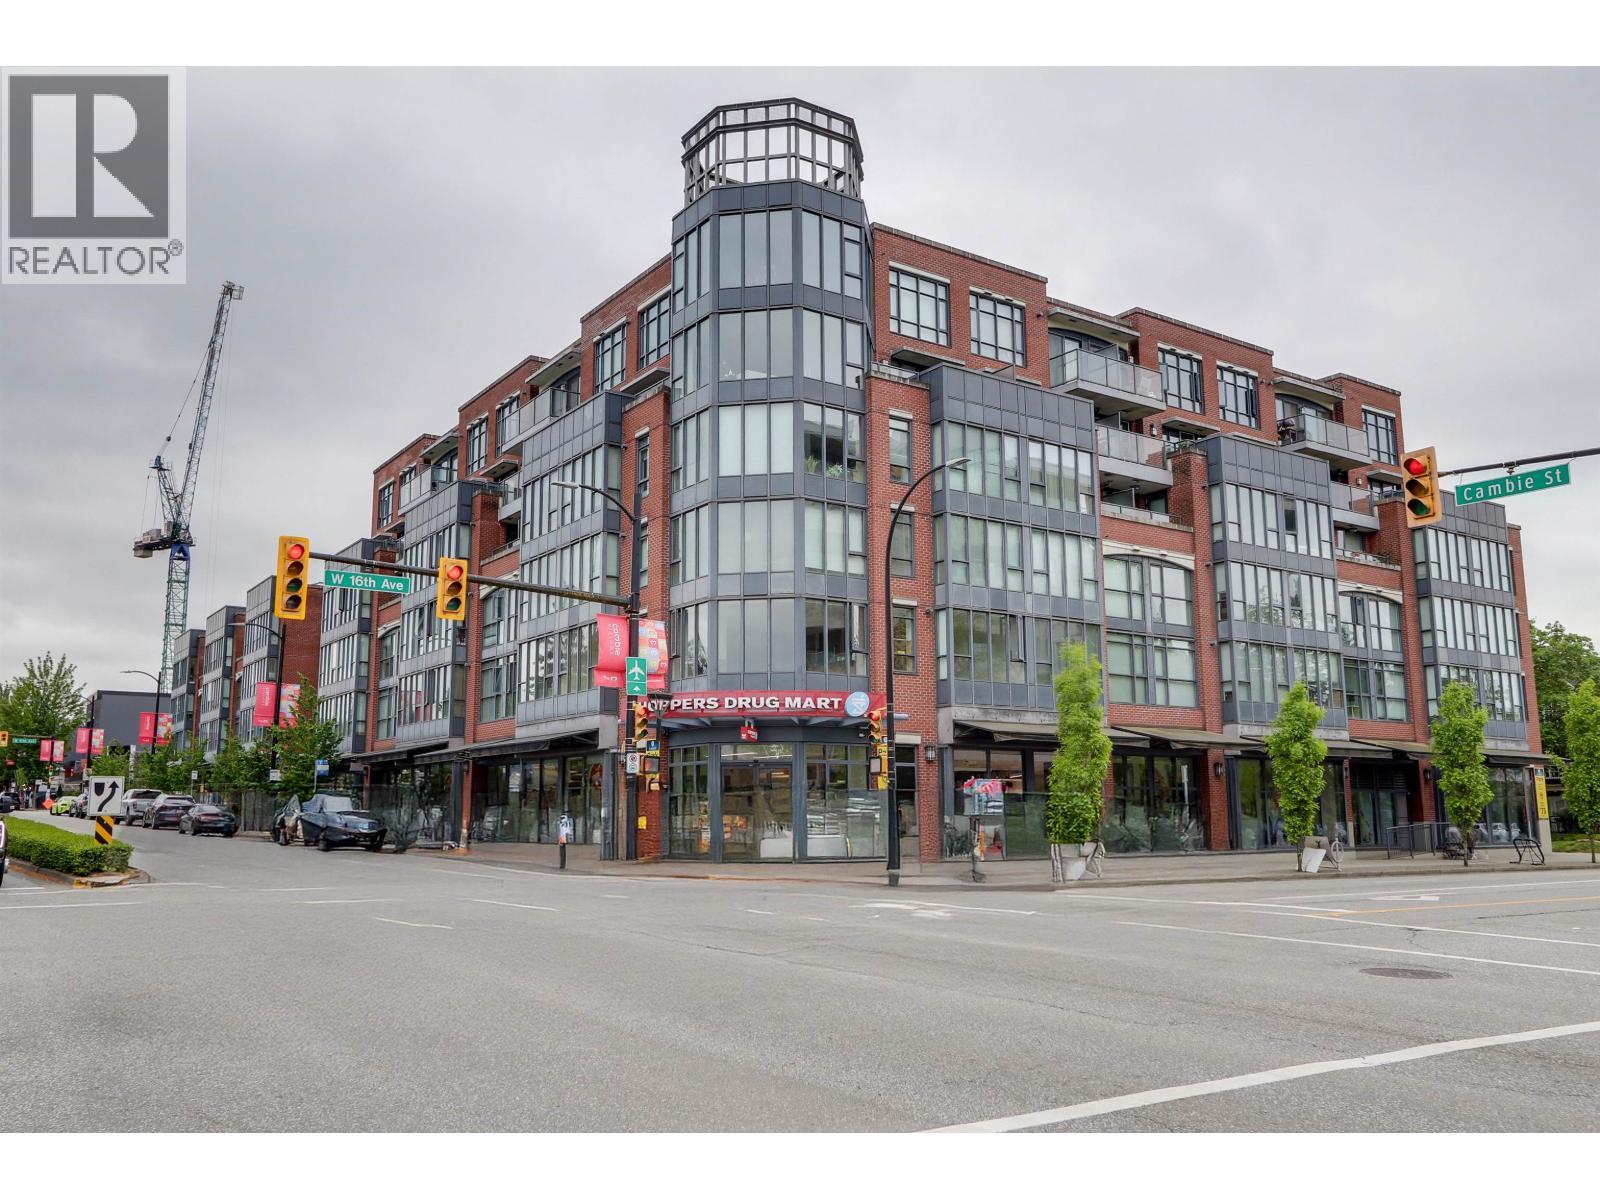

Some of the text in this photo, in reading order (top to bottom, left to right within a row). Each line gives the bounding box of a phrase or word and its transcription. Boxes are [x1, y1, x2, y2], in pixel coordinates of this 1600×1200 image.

[1463, 468, 1562, 501] Cambie St
[331, 573, 403, 591] W 16th Ave
[637, 696, 842, 712] HOPPERS DRUG MART
